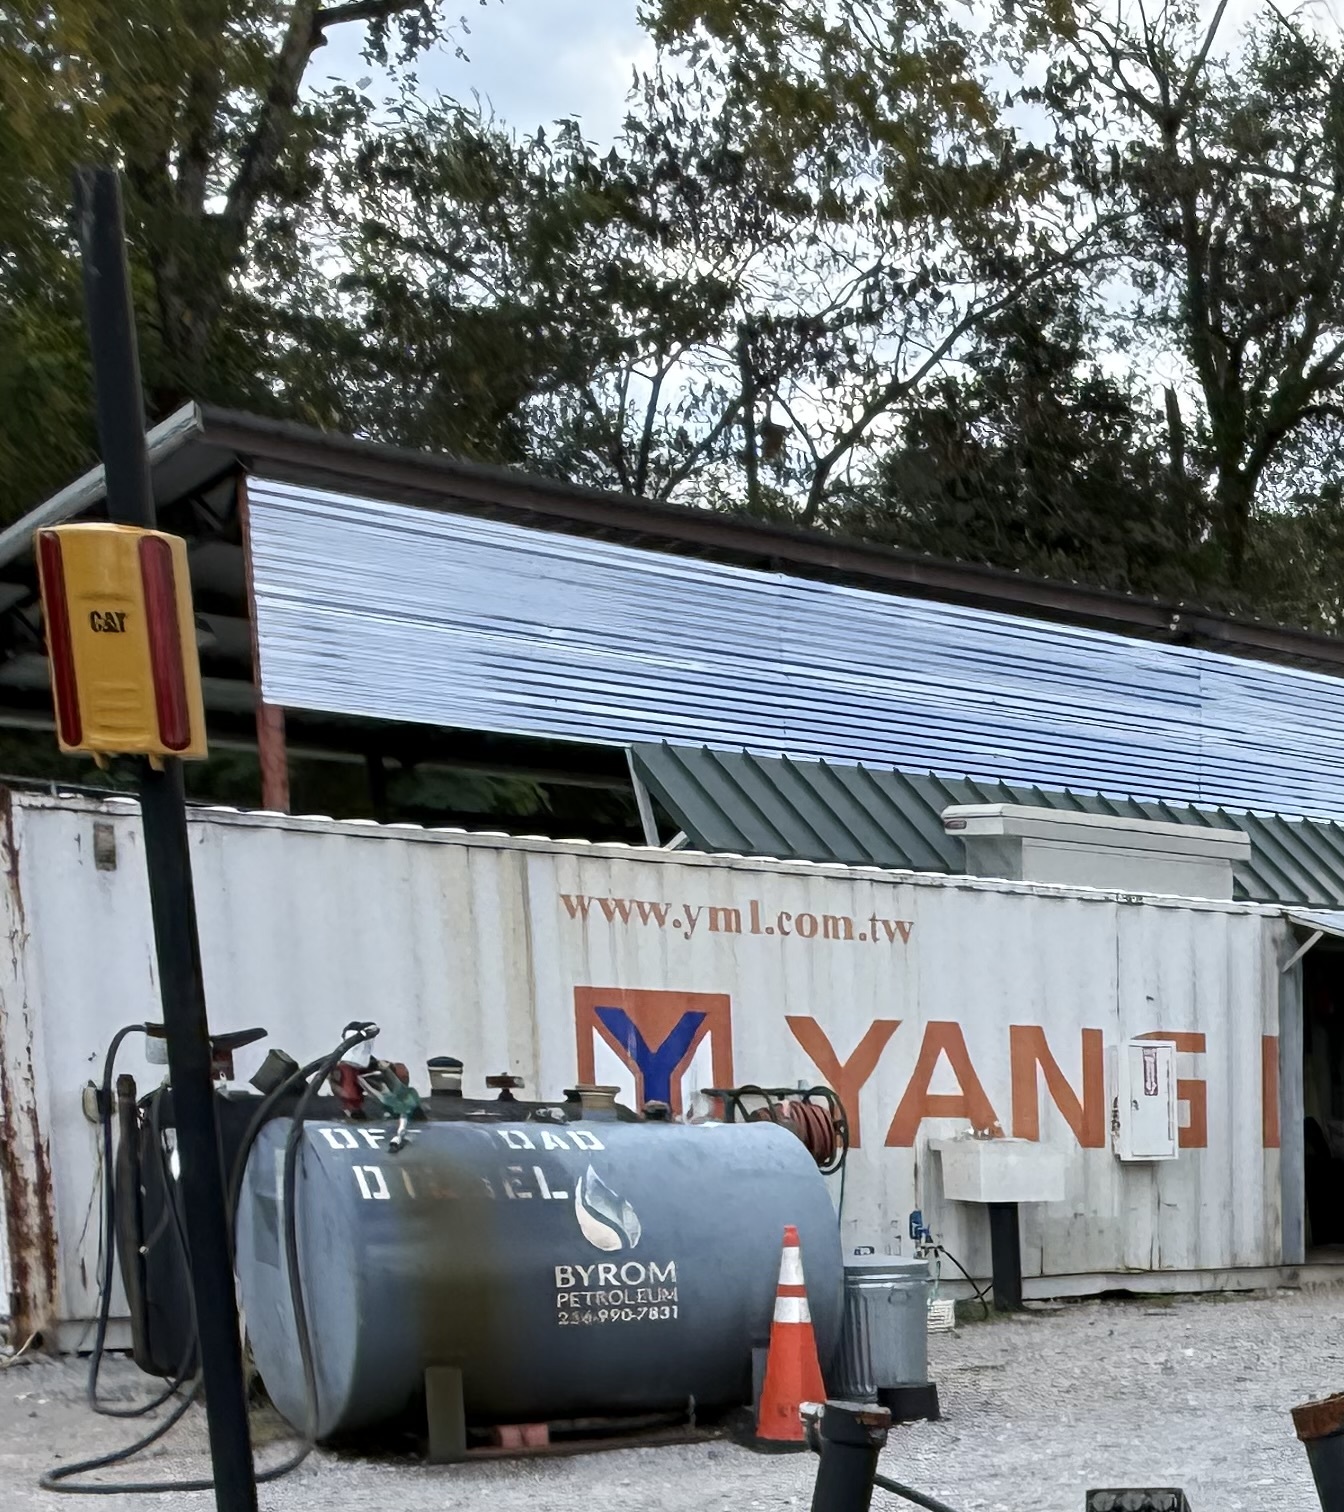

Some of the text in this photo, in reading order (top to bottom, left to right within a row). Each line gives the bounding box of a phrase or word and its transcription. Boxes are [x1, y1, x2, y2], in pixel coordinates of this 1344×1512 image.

[90, 610, 127, 633] CAT
[560, 893, 914, 944] www.yml.com.tw
[319, 1128, 422, 1150] OF
[554, 1260, 676, 1288] BYROM
[556, 1287, 679, 1308] PETROLEUM
